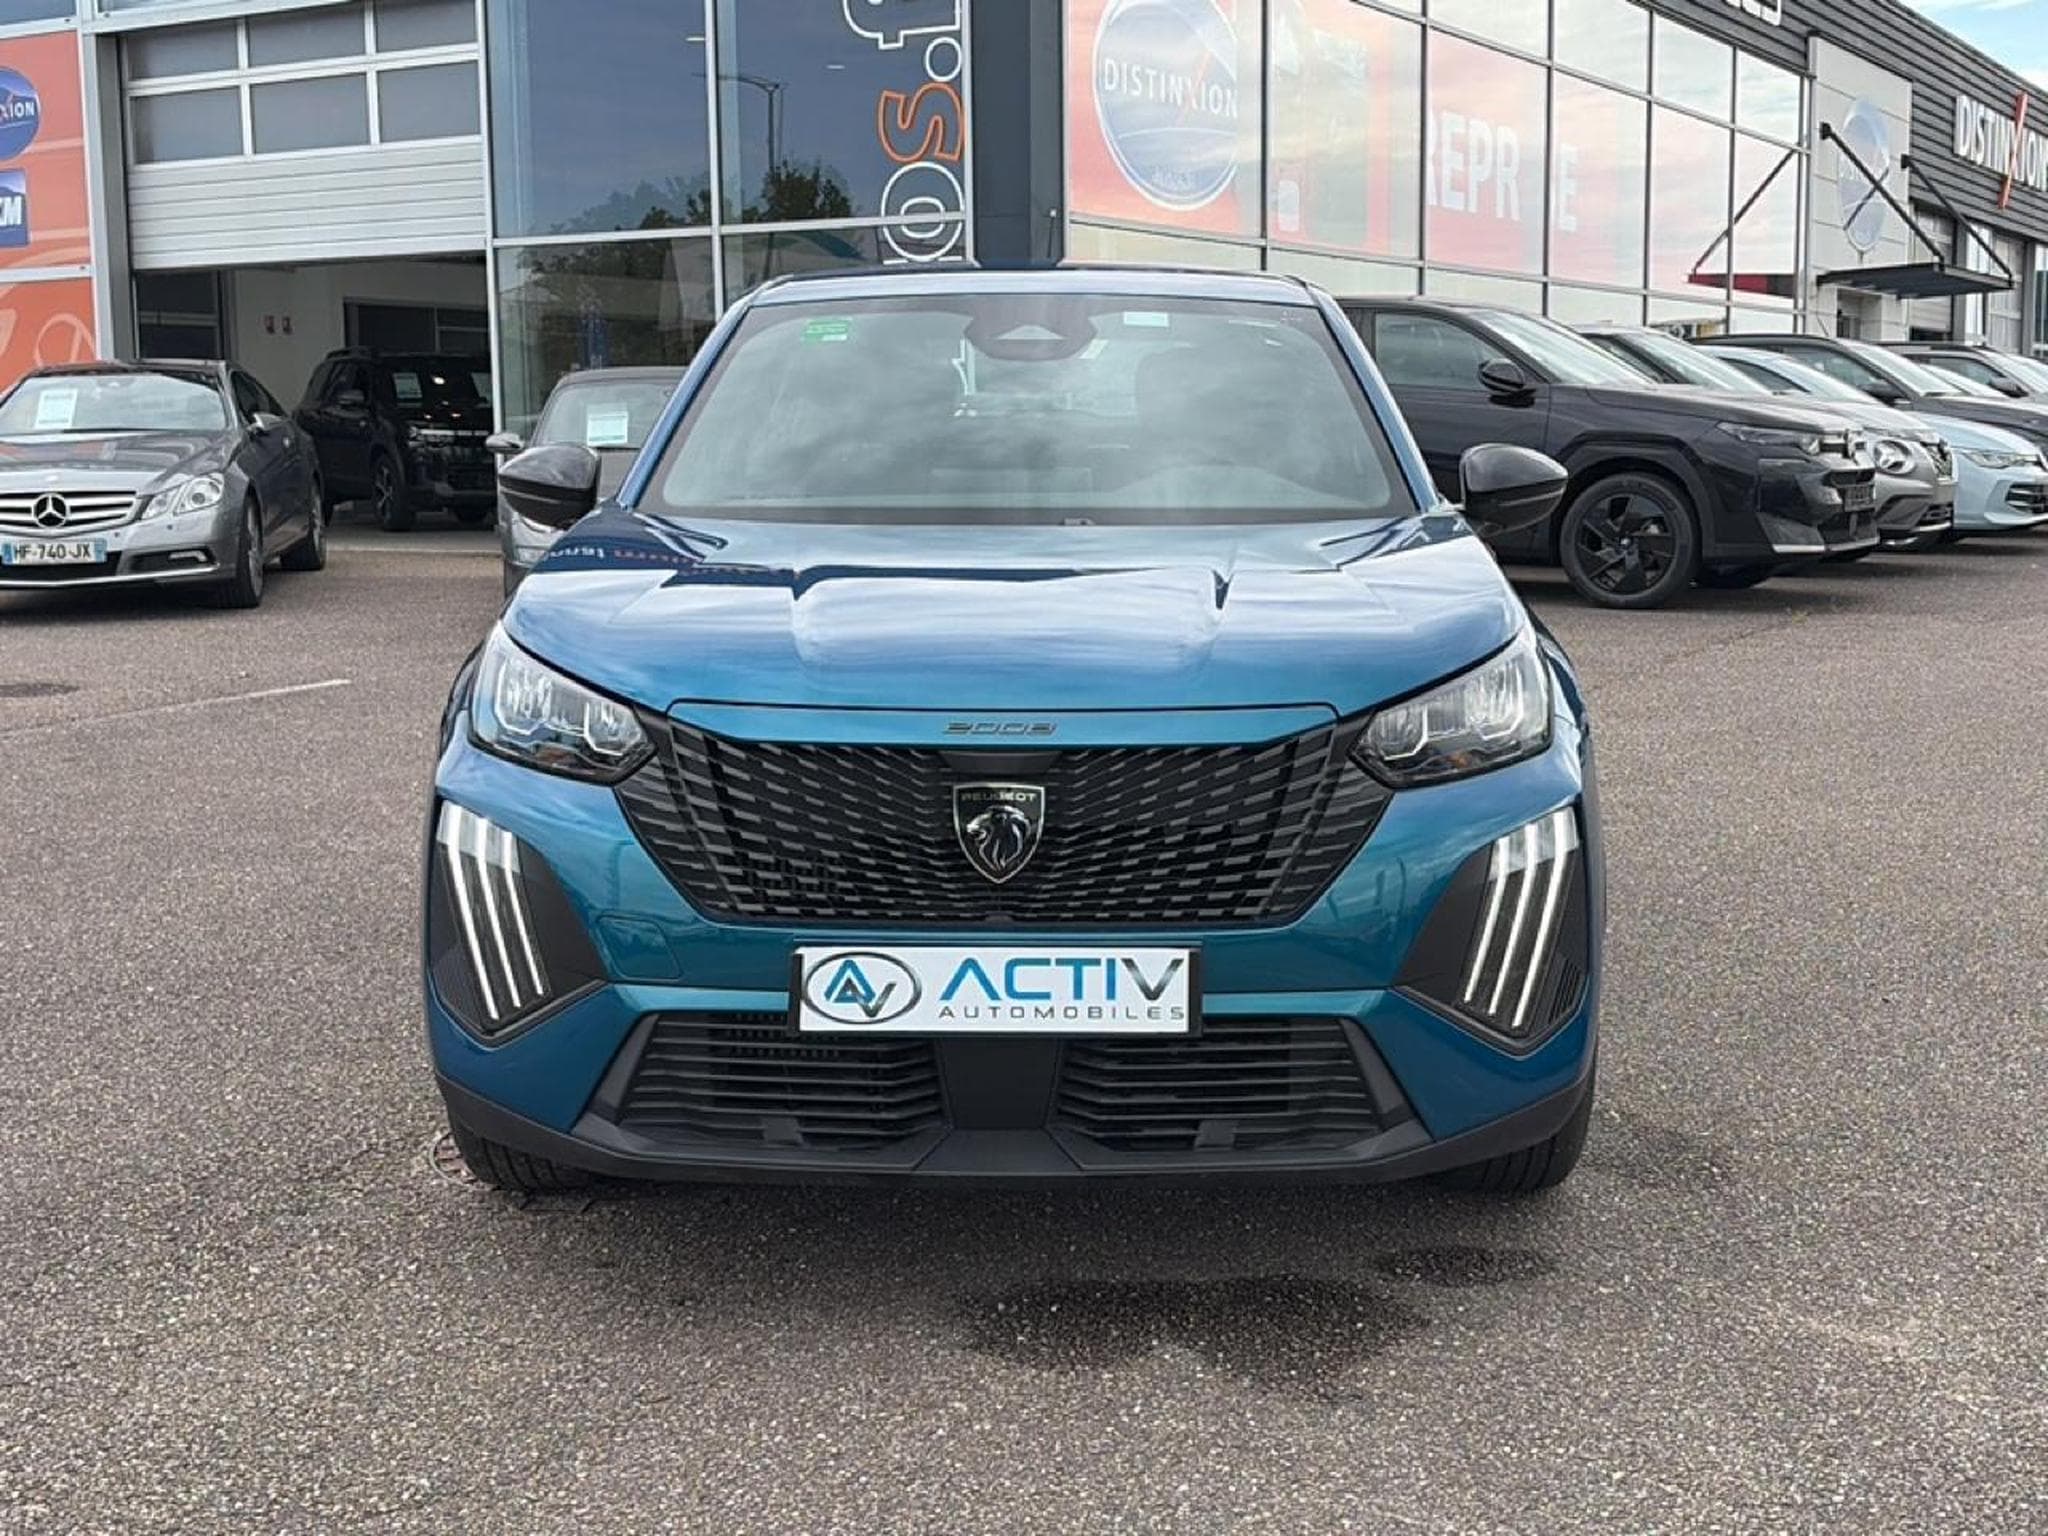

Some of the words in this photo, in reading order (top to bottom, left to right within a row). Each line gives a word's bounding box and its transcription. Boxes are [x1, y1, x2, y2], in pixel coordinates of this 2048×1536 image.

[1104, 56, 1237, 121] DISTINXION
[943, 721, 1058, 736] 2008
[961, 792, 1036, 802] PEUGEOT
[940, 957, 1184, 1001] ACTIV
[938, 1005, 1184, 1020] AUTOMOBILES
